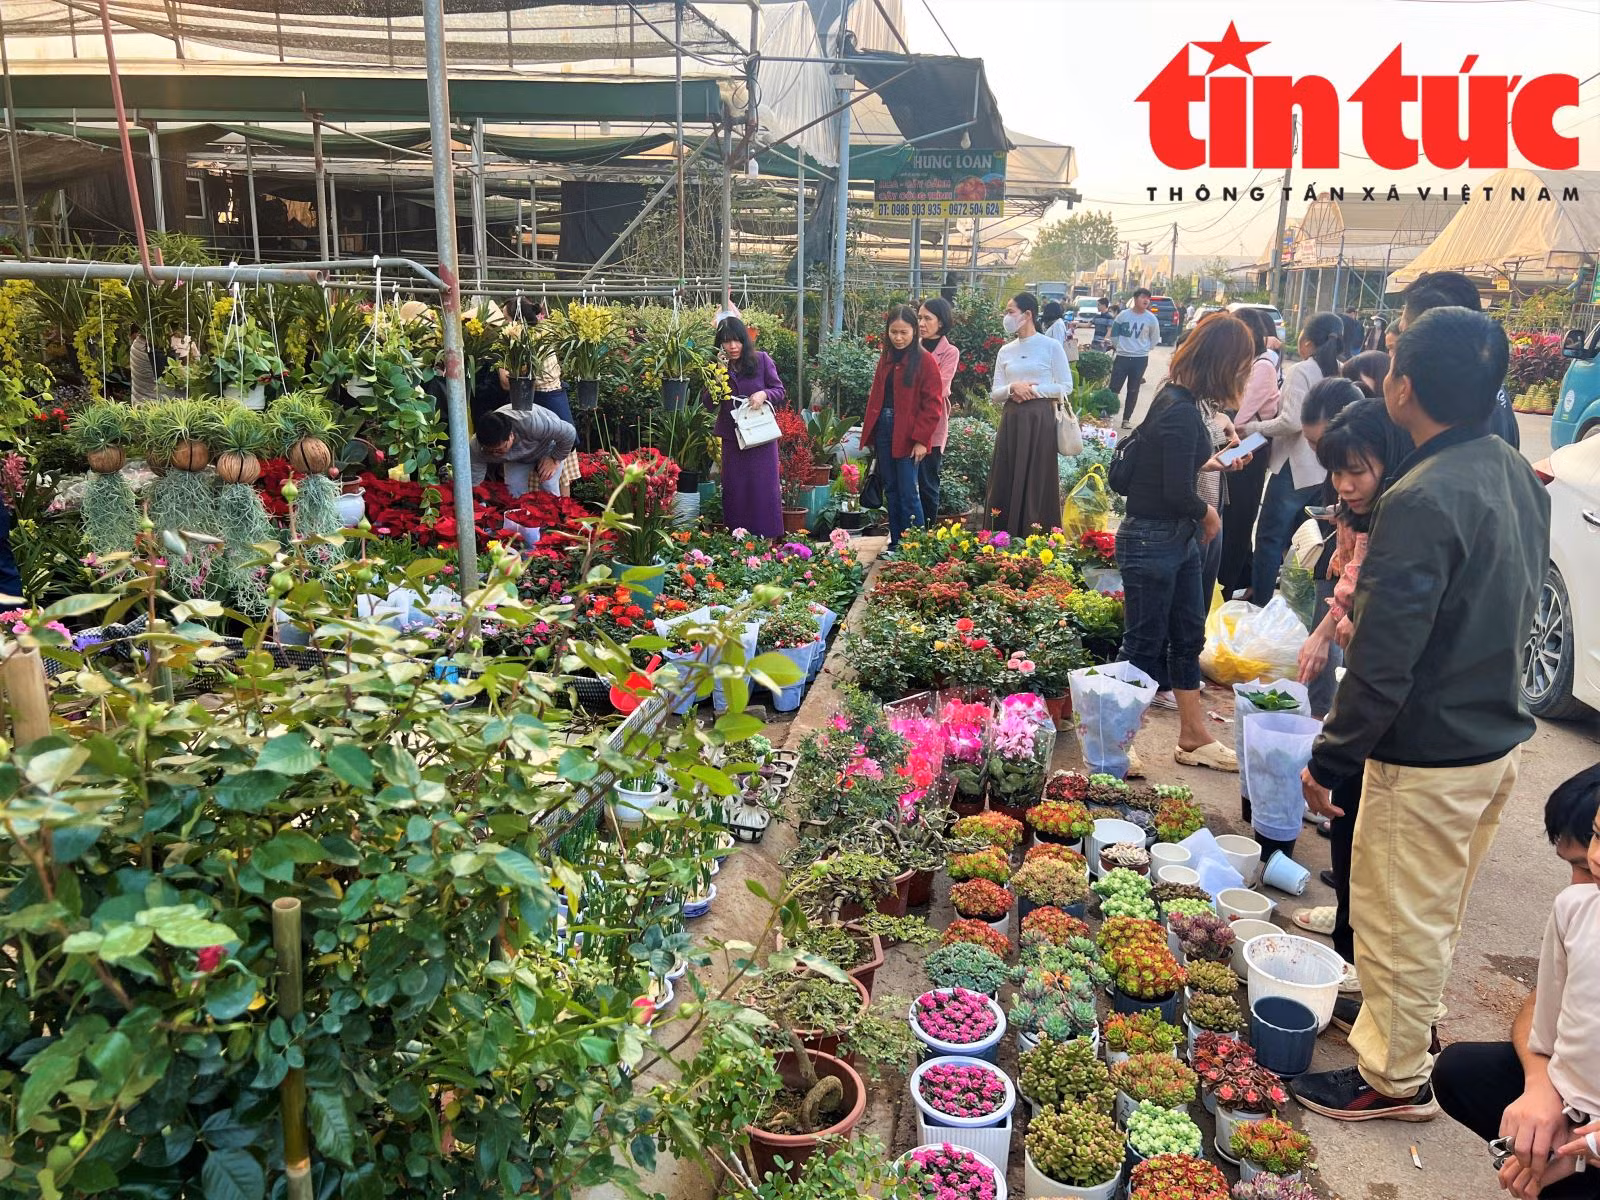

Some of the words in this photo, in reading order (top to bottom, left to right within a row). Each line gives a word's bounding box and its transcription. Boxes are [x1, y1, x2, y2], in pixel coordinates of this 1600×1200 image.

[956, 155, 992, 169] LOAN
[892, 203, 909, 216] 0986
[911, 203, 926, 216] 903
[928, 203, 942, 216] 935
[949, 203, 968, 216] 0972
[970, 203, 983, 216] 504
[985, 203, 1000, 216] 624
